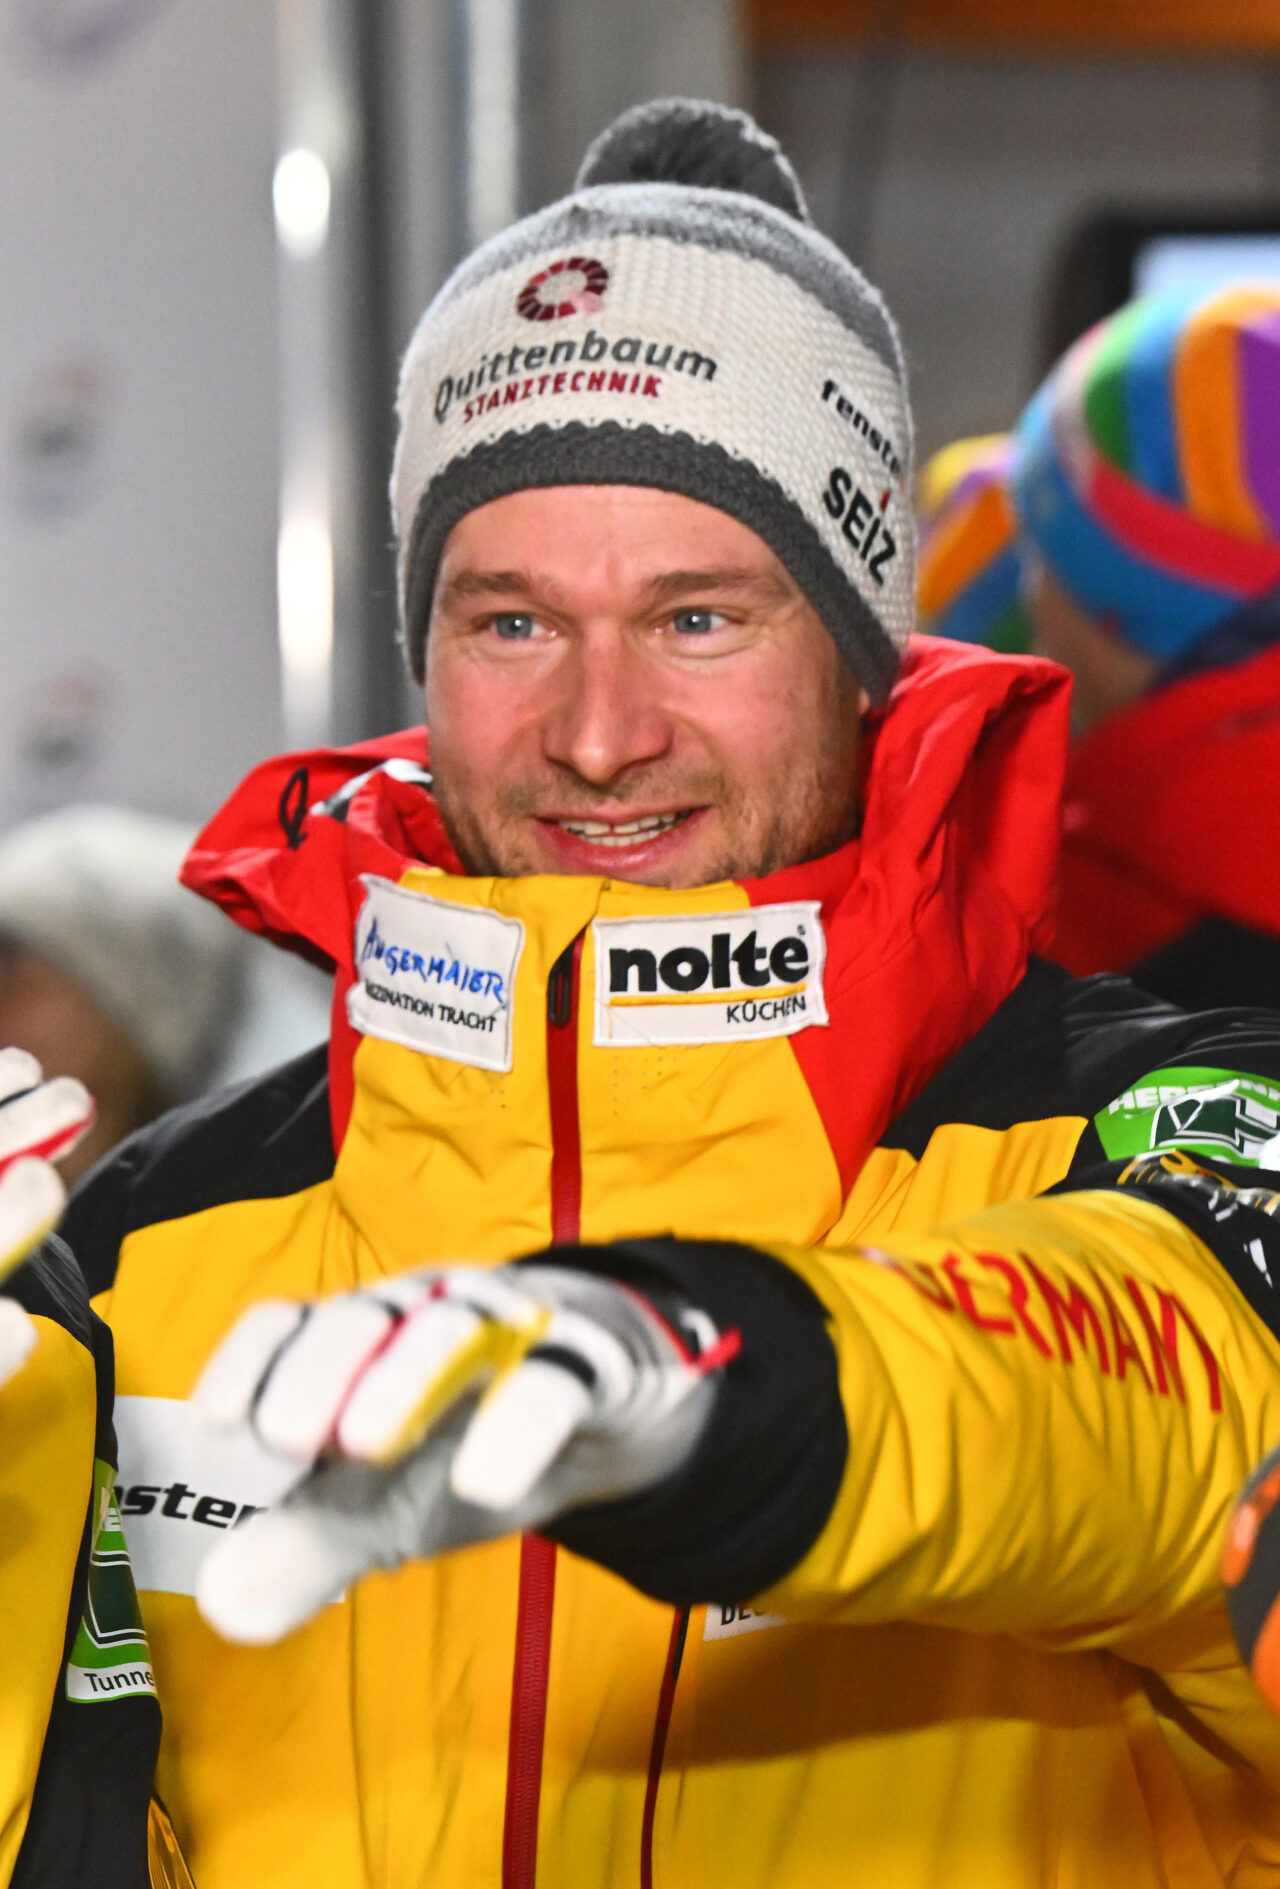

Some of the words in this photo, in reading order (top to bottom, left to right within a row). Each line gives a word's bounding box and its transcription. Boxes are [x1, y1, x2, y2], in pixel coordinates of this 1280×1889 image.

[433, 329, 718, 424] Quittenbaum
[463, 370, 662, 424] STANZTECHNIK
[609, 930, 810, 994] nolte
[438, 1004, 497, 1033] TRACHT
[726, 995, 807, 1025] KÜCHEN
